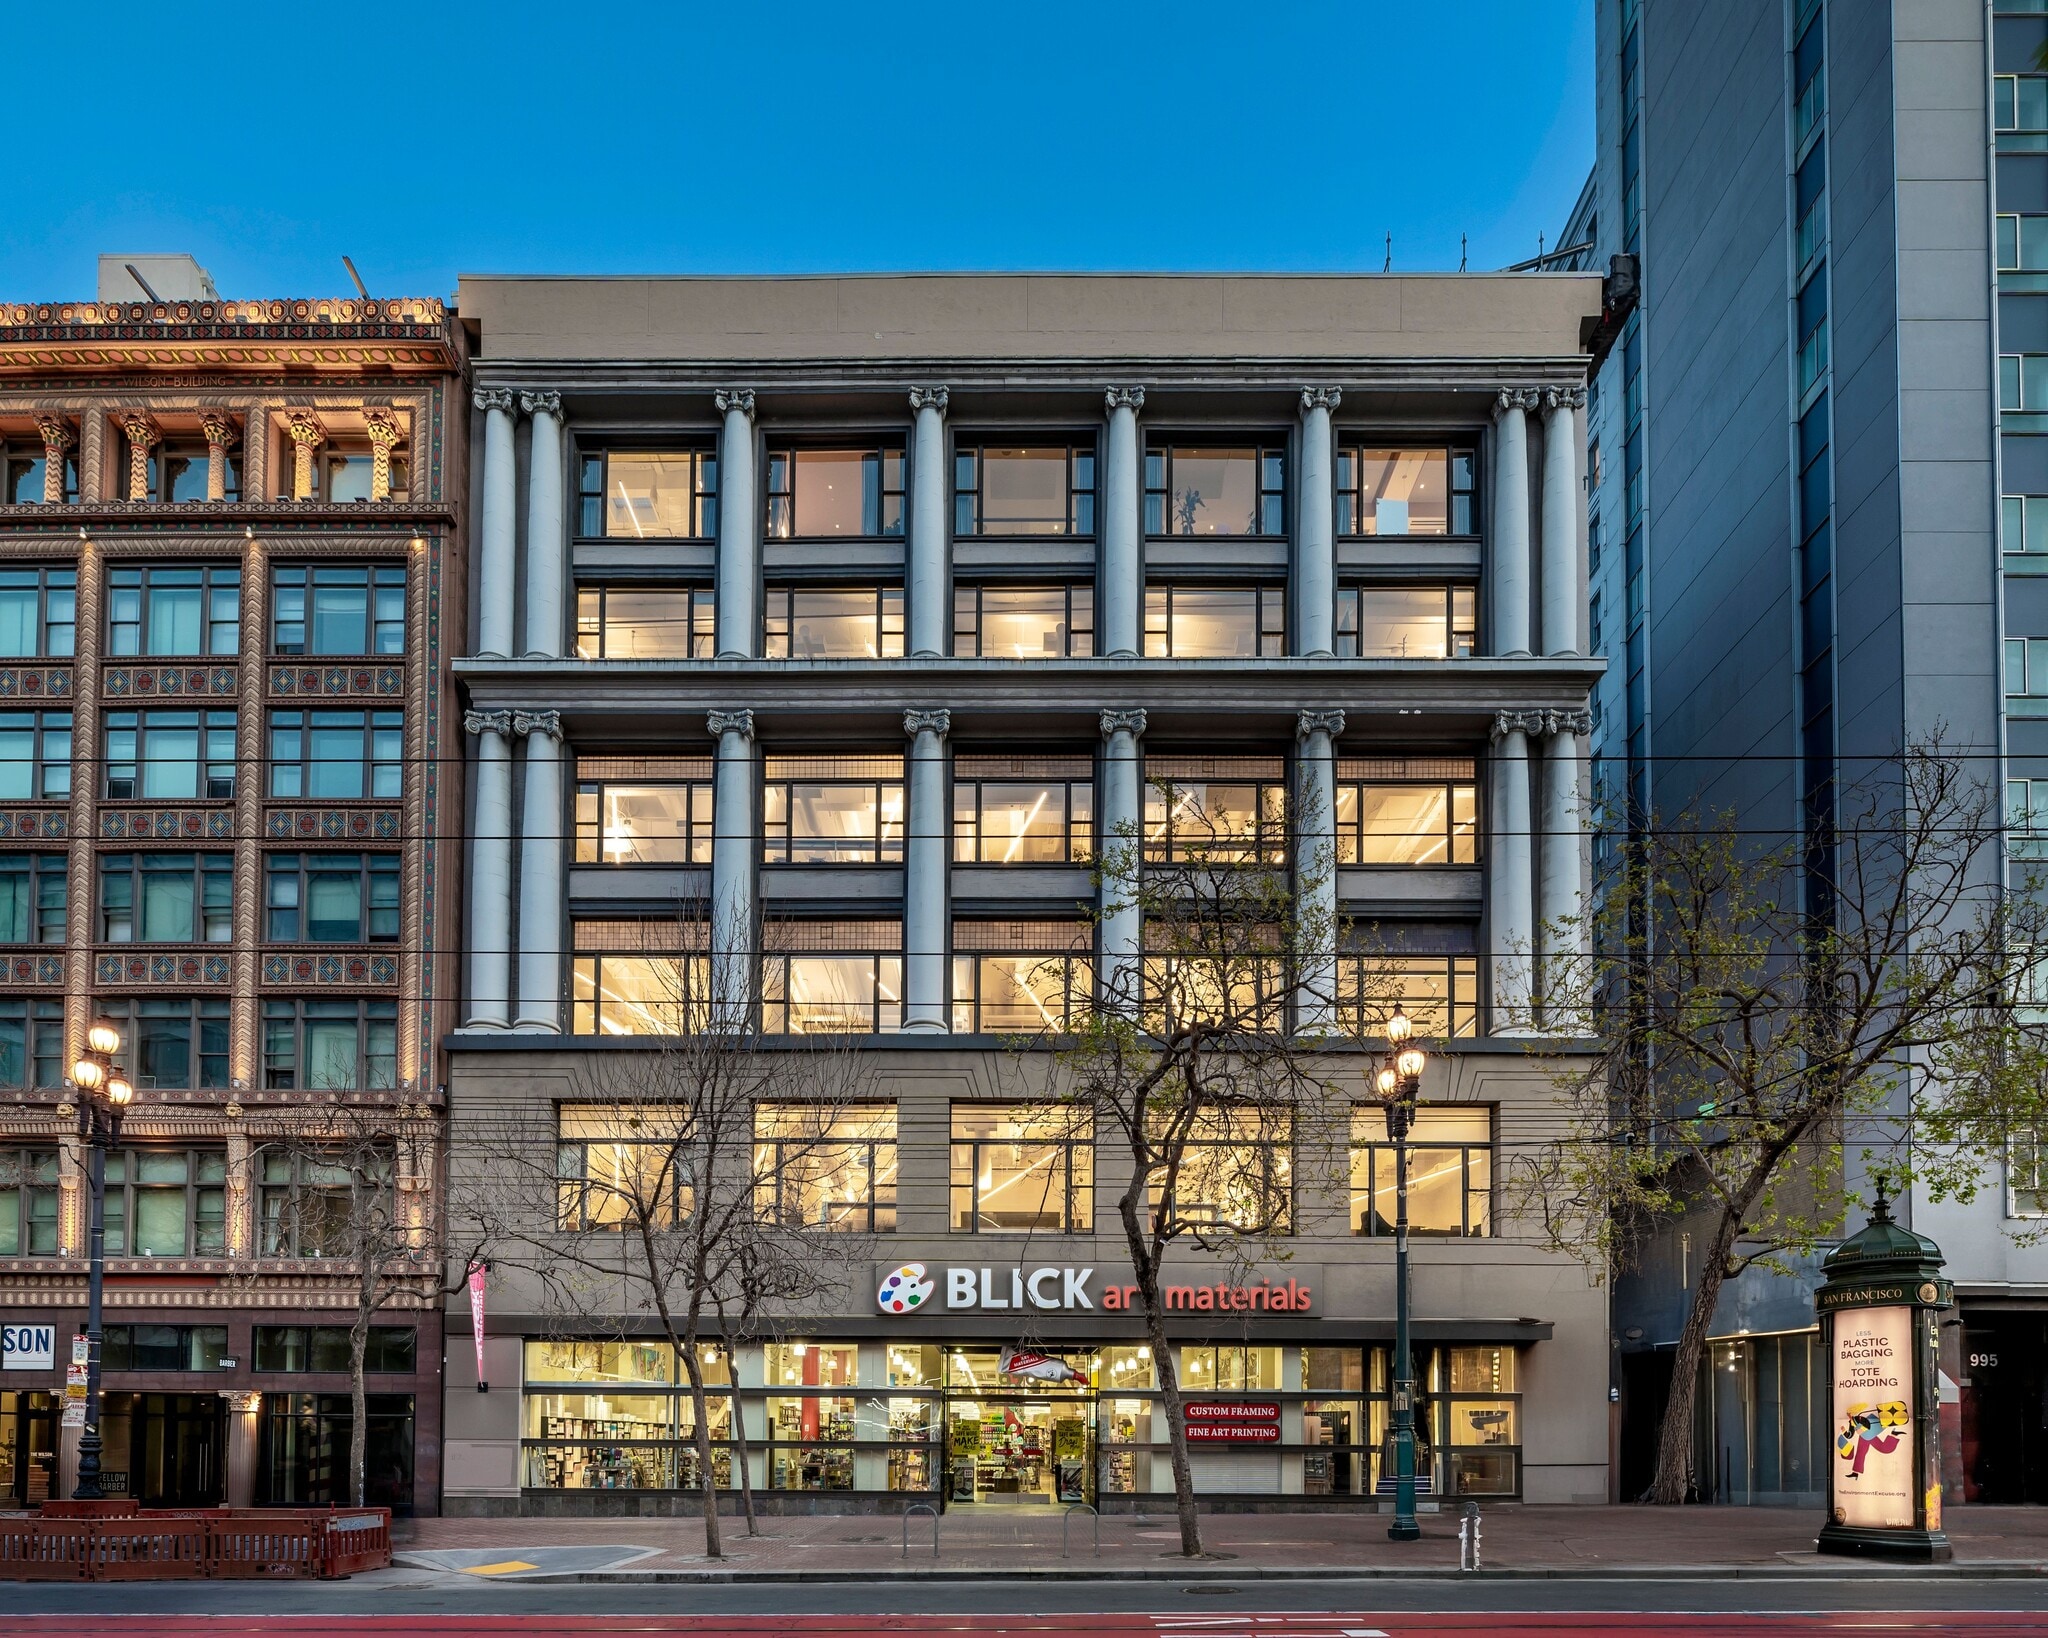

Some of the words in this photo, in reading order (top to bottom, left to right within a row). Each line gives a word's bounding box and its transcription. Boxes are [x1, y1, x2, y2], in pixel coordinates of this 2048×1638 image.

[123, 376, 166, 387] WILSON
[173, 376, 226, 387] BUILDING
[947, 1268, 1094, 1309] BLICK
[1103, 1285, 1142, 1309] ar
[1165, 1278, 1311, 1310] materials
[1824, 1294, 1839, 1305] SAN
[1840, 1289, 1902, 1303] FRANCISCO
[3, 1327, 50, 1354] SON
[1843, 1337, 1889, 1349] PLASTIC
[1841, 1348, 1893, 1360] BAGGING
[1970, 1353, 1999, 1367] 995
[219, 1359, 236, 1368] BARBER
[1851, 1367, 1880, 1377] TOTE
[1839, 1377, 1898, 1389] HOARDING
[1190, 1407, 1229, 1416] CUSTOM
[1231, 1407, 1275, 1416] FRAMING
[1188, 1427, 1210, 1436] FINE
[1211, 1428, 1230, 1437] ART
[1231, 1428, 1276, 1437] PRINTING
[954, 1436, 979, 1446] MAKE
